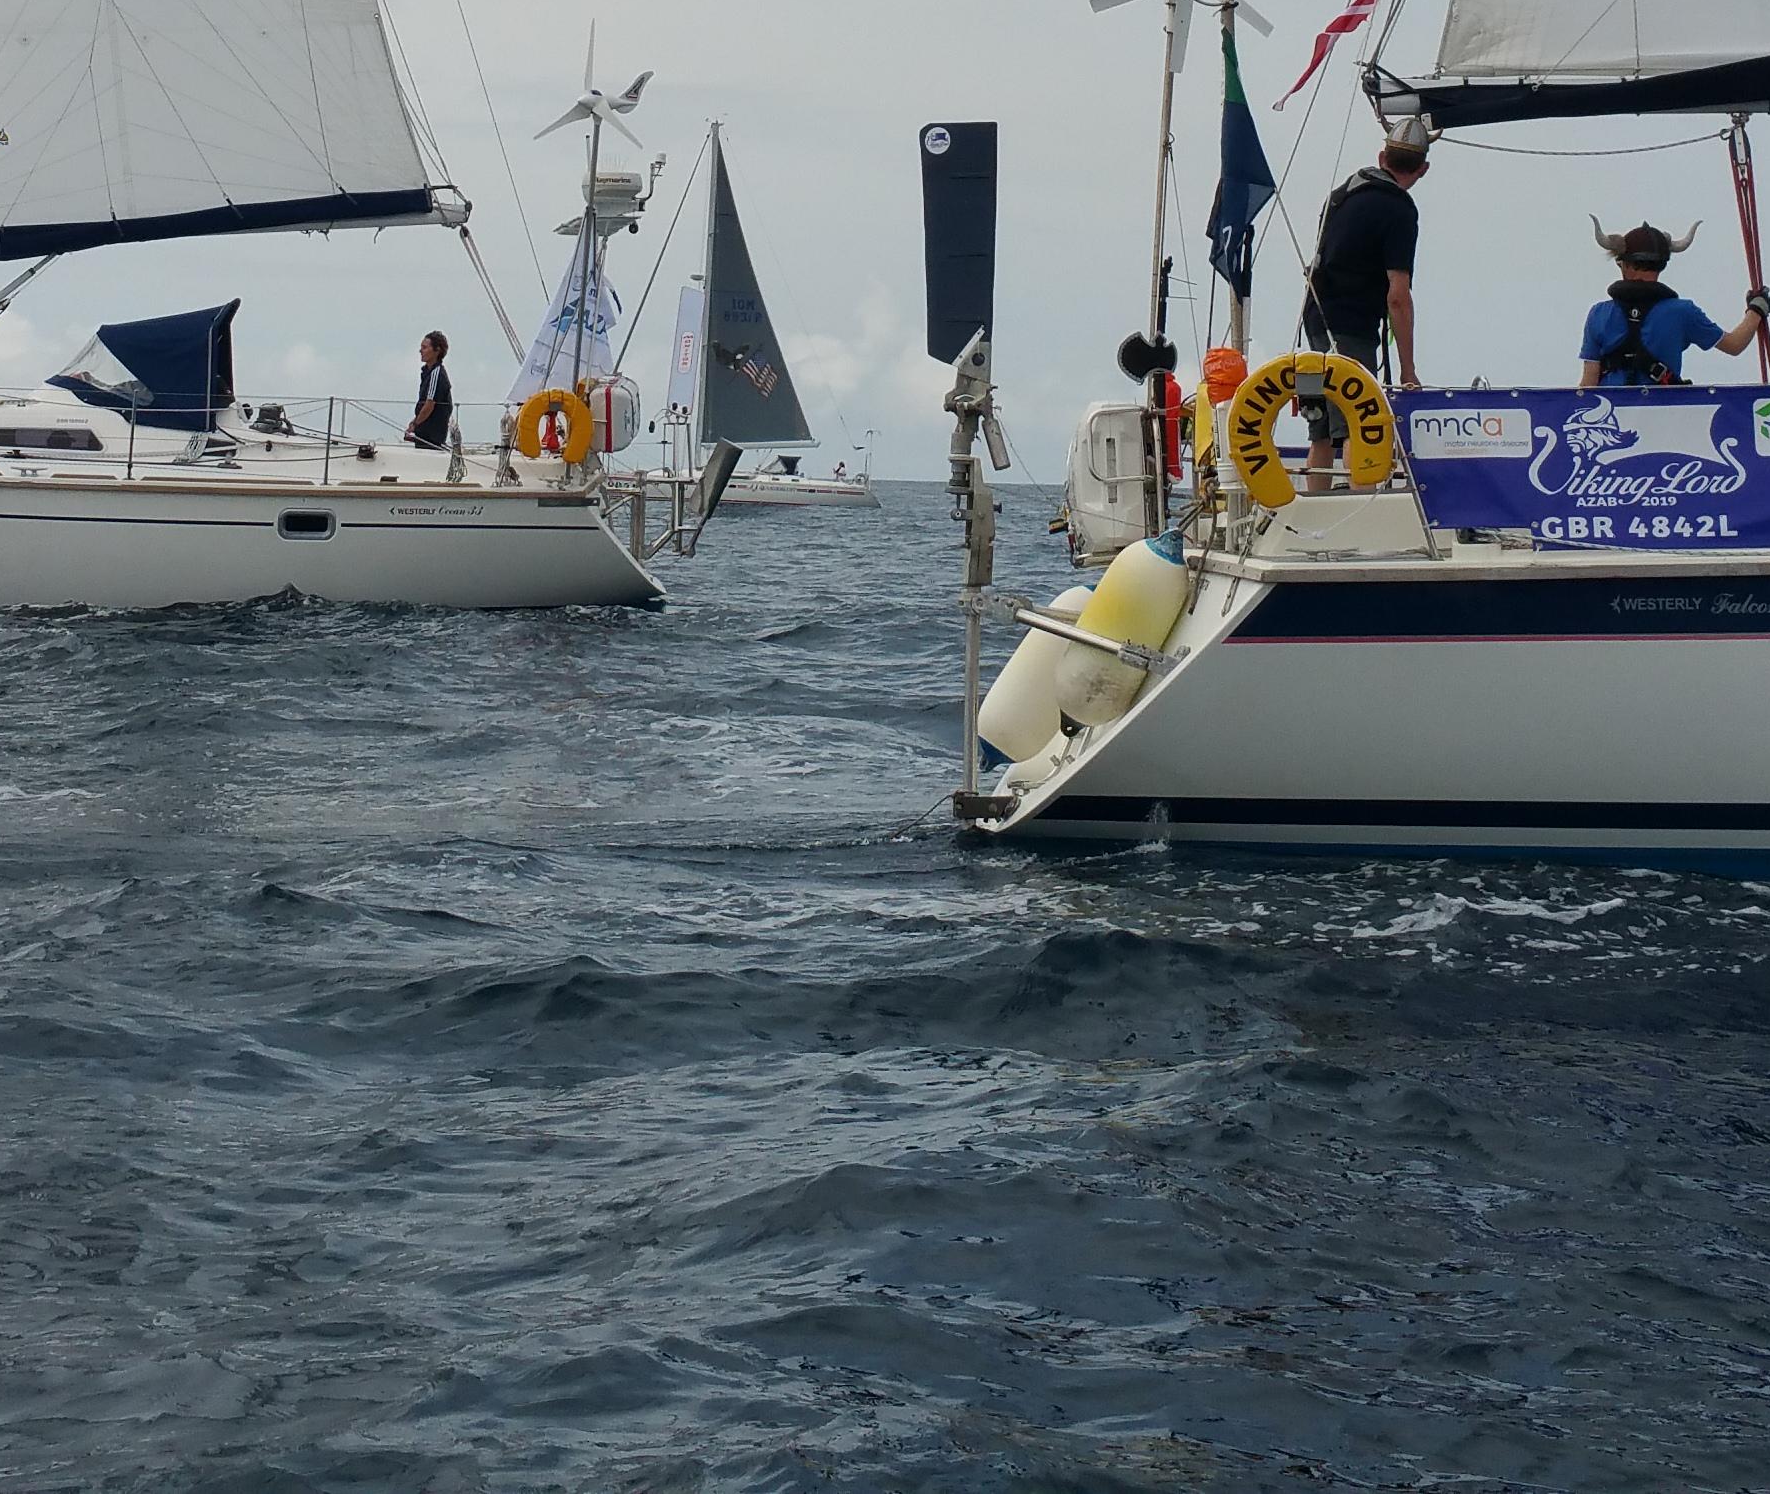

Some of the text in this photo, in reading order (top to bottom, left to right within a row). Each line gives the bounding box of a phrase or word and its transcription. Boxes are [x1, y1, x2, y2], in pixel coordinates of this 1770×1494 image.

[1323, 366, 1384, 445] LORD
[1414, 411, 1503, 437] mnda
[1529, 455, 1747, 505] Viking Lord
[1575, 496, 1678, 507] AZAB 2019
[1540, 514, 1739, 539] GBR 4842L
[1623, 597, 1703, 612] WESTERLY
